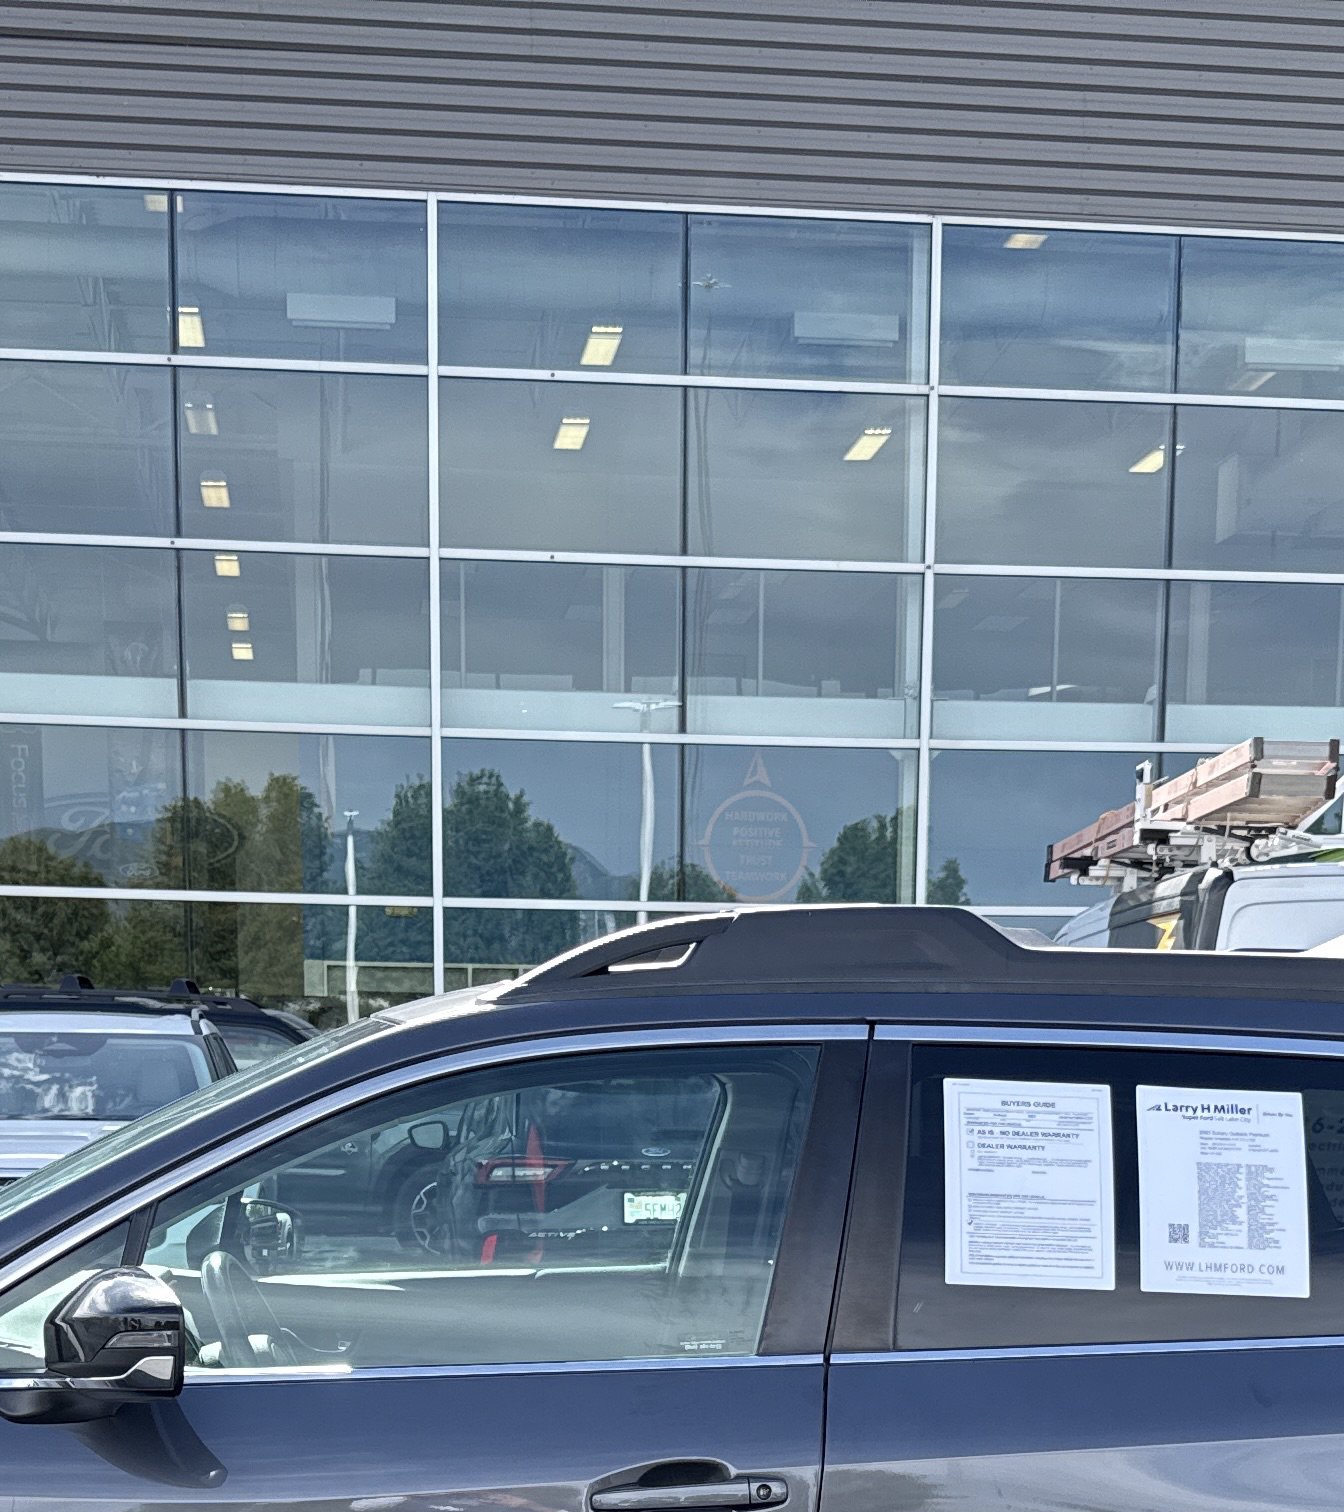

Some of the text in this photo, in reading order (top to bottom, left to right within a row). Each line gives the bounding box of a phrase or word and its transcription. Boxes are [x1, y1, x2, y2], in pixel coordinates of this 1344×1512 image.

[10, 744, 29, 809] FOCUS
[724, 810, 789, 822] HARDWORK
[732, 826, 782, 837] POSITIVE
[740, 855, 773, 865] TRUST
[1033, 1101, 1056, 1109] GUIDE
[1164, 1102, 1253, 1116] Larry H Miller
